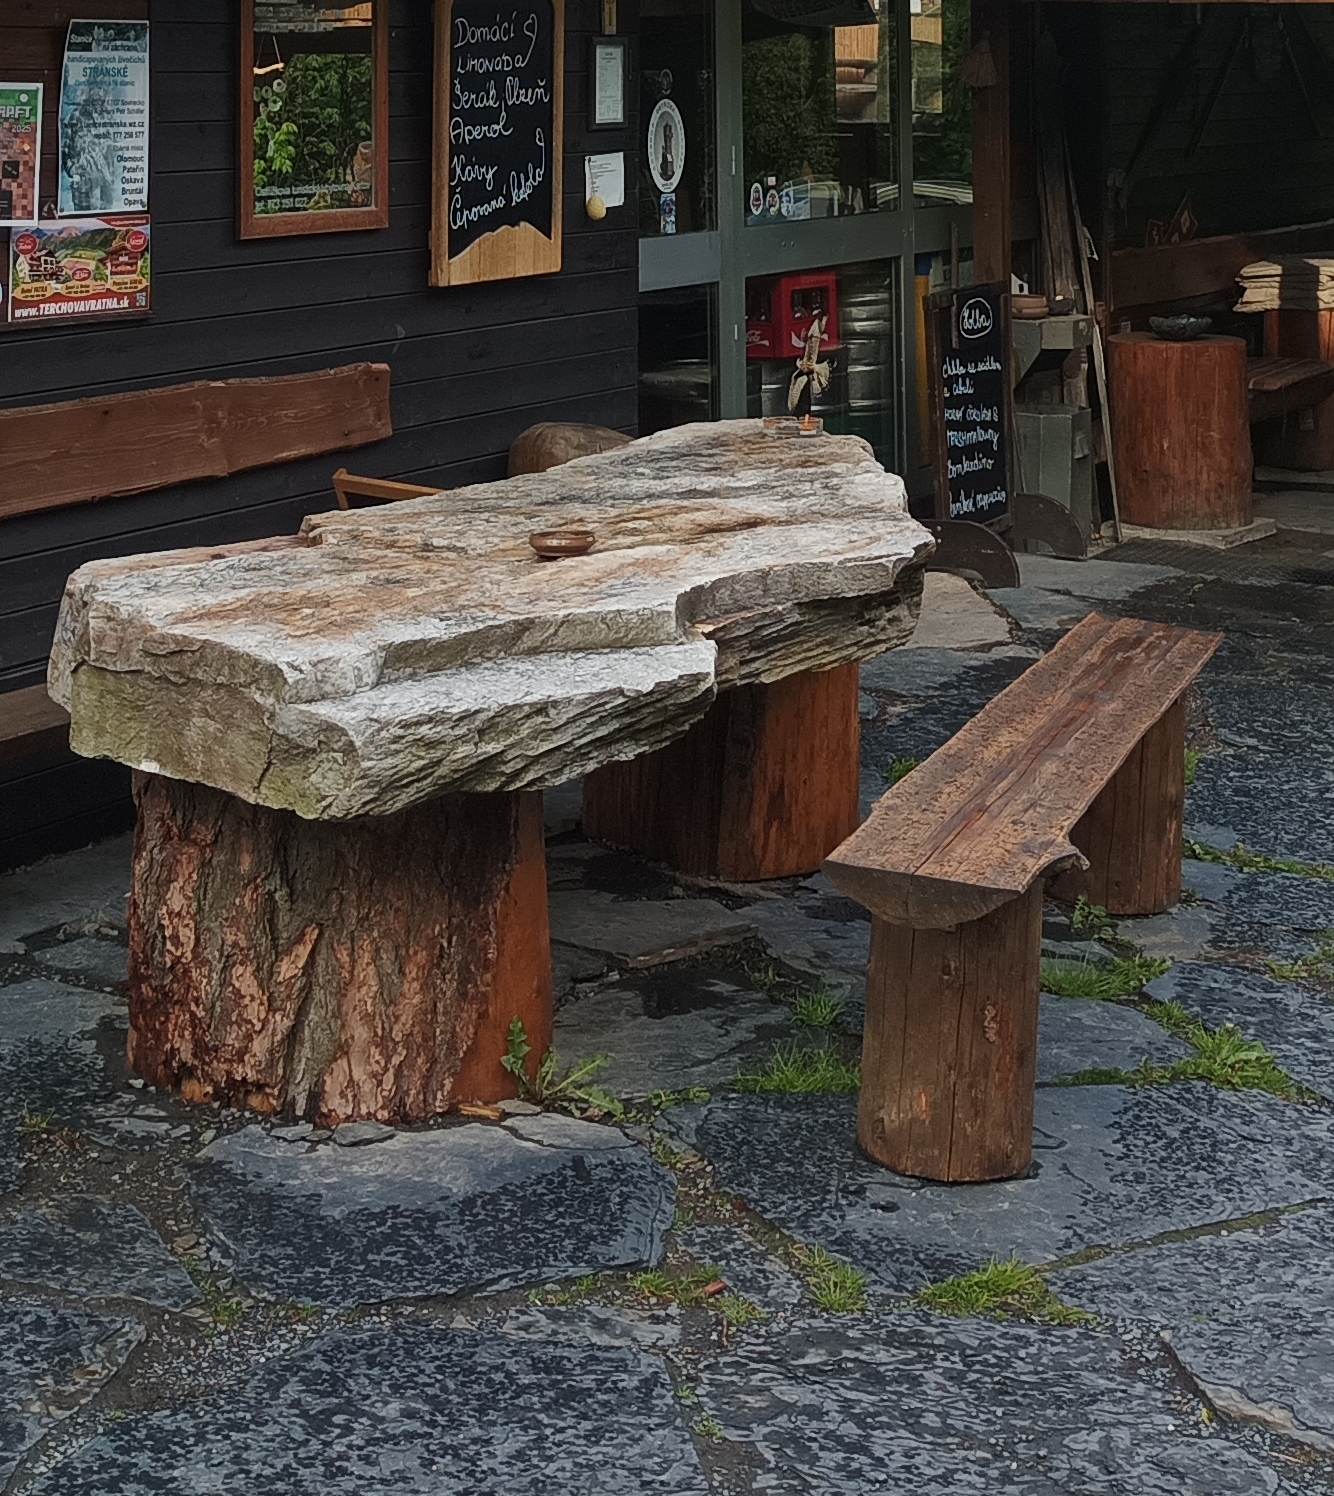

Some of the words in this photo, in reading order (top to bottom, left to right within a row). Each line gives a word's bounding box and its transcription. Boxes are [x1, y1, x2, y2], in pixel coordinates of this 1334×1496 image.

[454, 11, 517, 48] Domácí
[70, 34, 92, 43] Stanice
[450, 110, 513, 144] Aperol
[121, 176, 143, 184] Oskava
[124, 198, 143, 207] Opava
